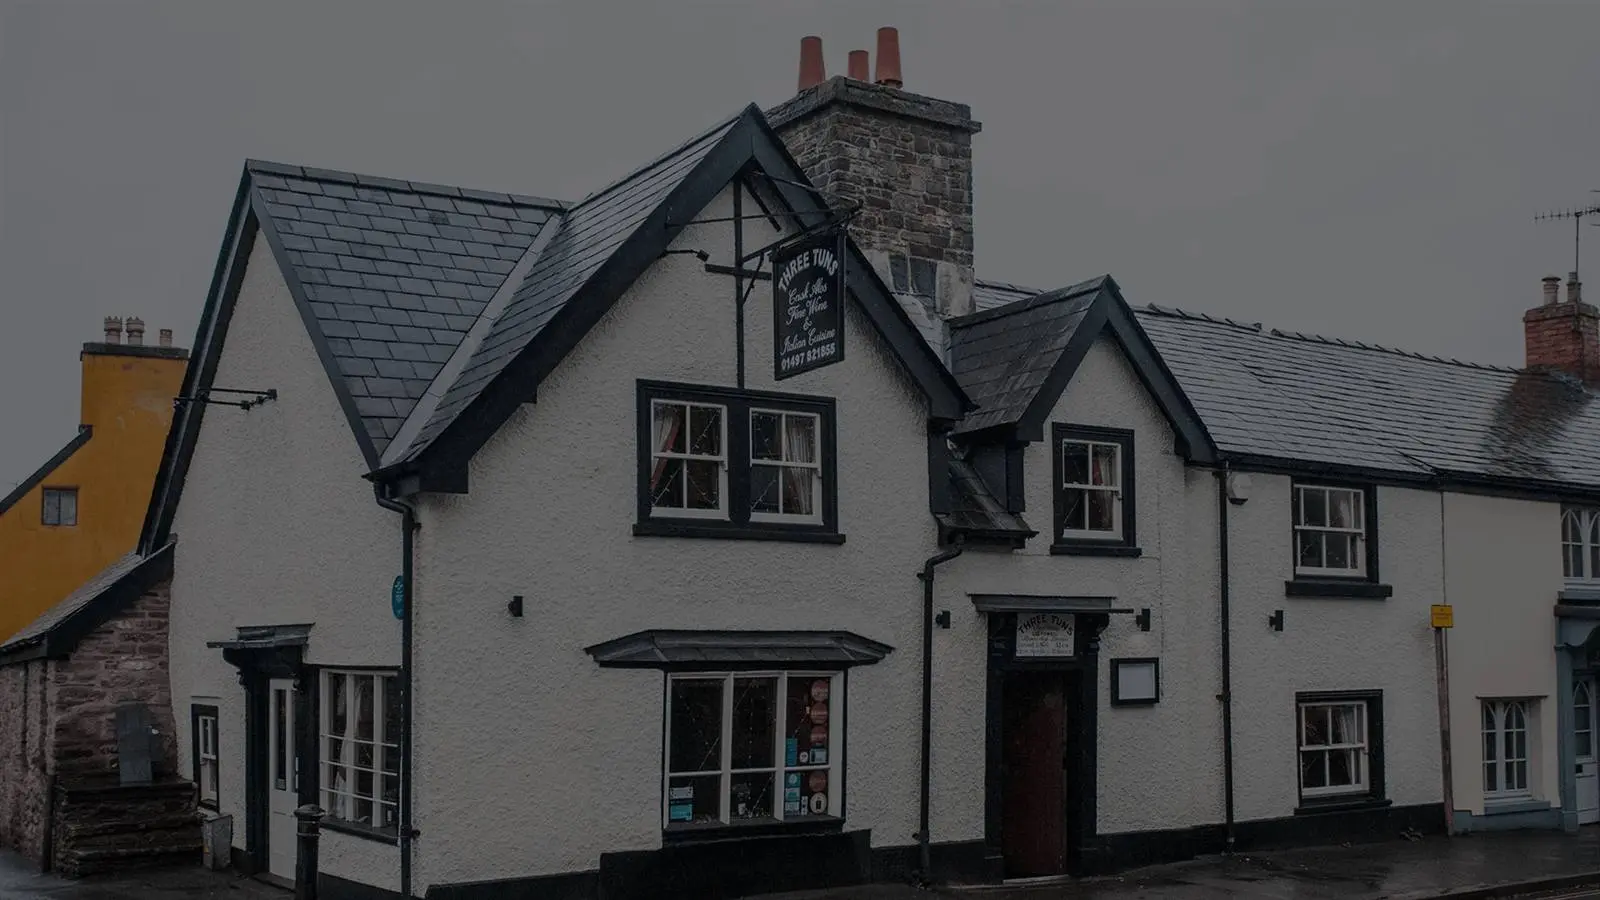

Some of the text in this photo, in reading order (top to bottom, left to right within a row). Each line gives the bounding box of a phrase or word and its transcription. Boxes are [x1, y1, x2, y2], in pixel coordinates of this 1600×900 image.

[778, 248, 839, 292] THREE TUNS
[788, 281, 810, 305] Cask
[786, 296, 829, 327] Fine Wine
[803, 316, 813, 331] &
[780, 327, 836, 356] Italian Cuisine
[781, 352, 805, 371] 01497
[1018, 614, 1074, 636] THREE TUNS
